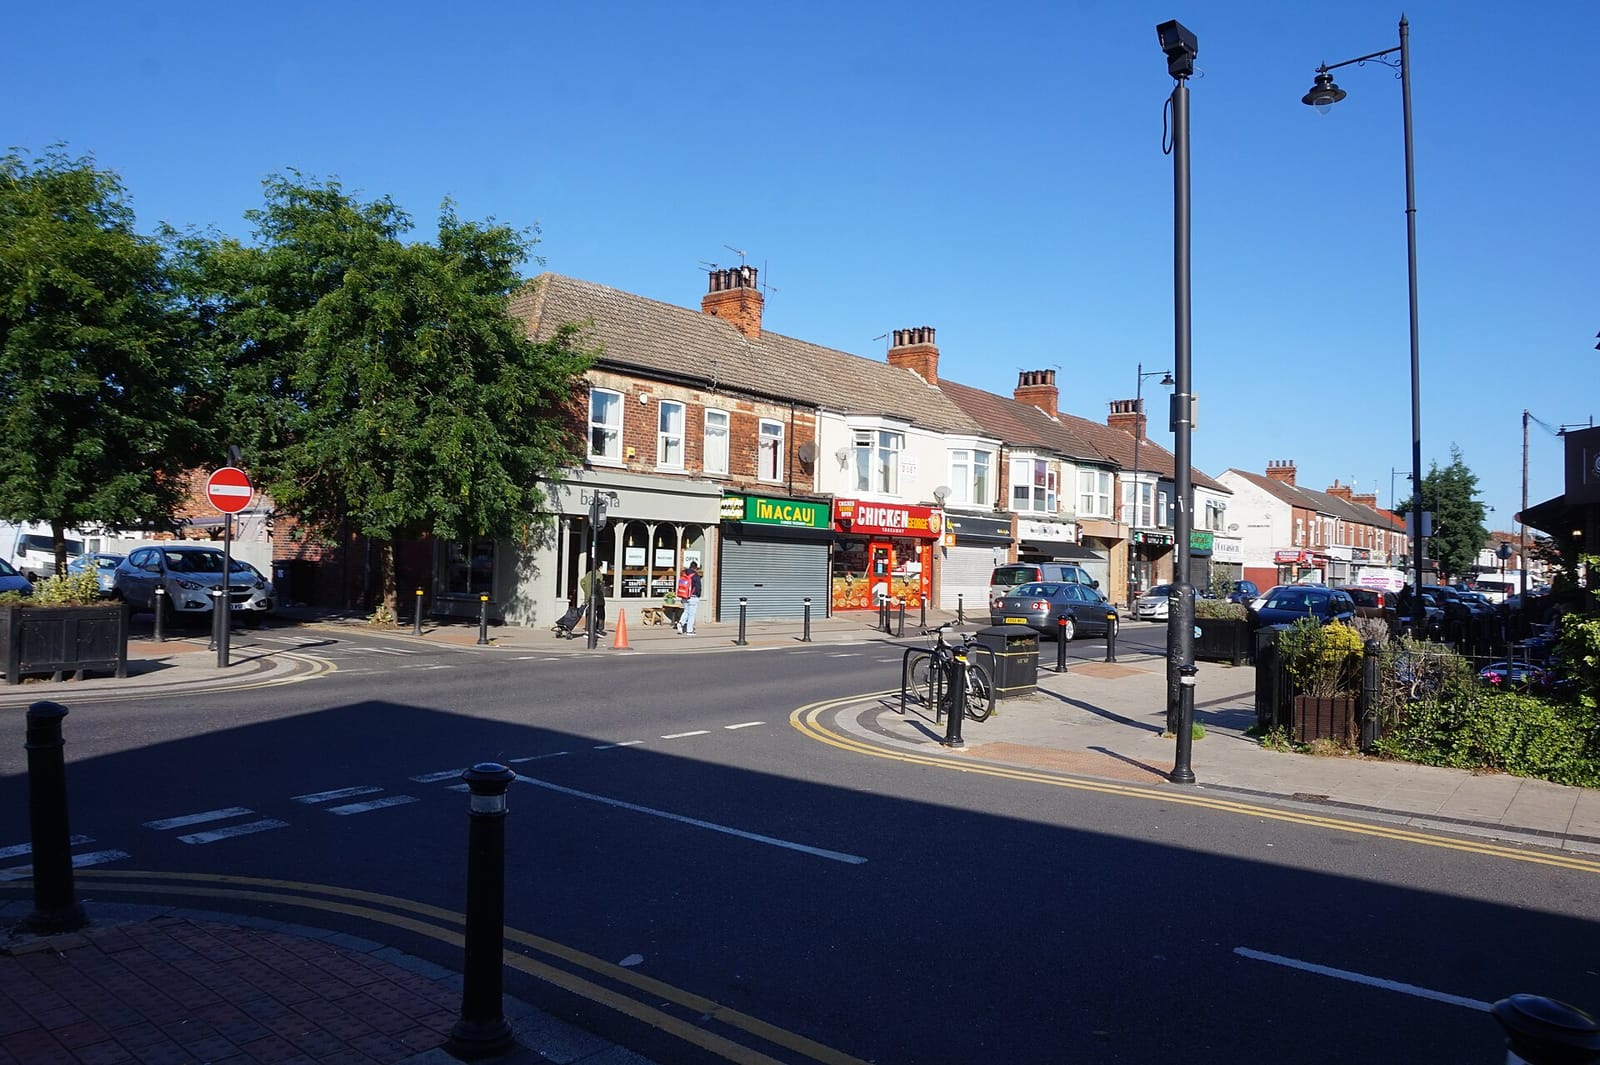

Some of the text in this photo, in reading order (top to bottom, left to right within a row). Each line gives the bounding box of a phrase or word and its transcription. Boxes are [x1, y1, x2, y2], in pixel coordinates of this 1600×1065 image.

[580, 488, 620, 508] basta
[761, 503, 811, 522] MACAU
[857, 506, 909, 528] CHICKEN
[907, 517, 928, 529] GEORGE
